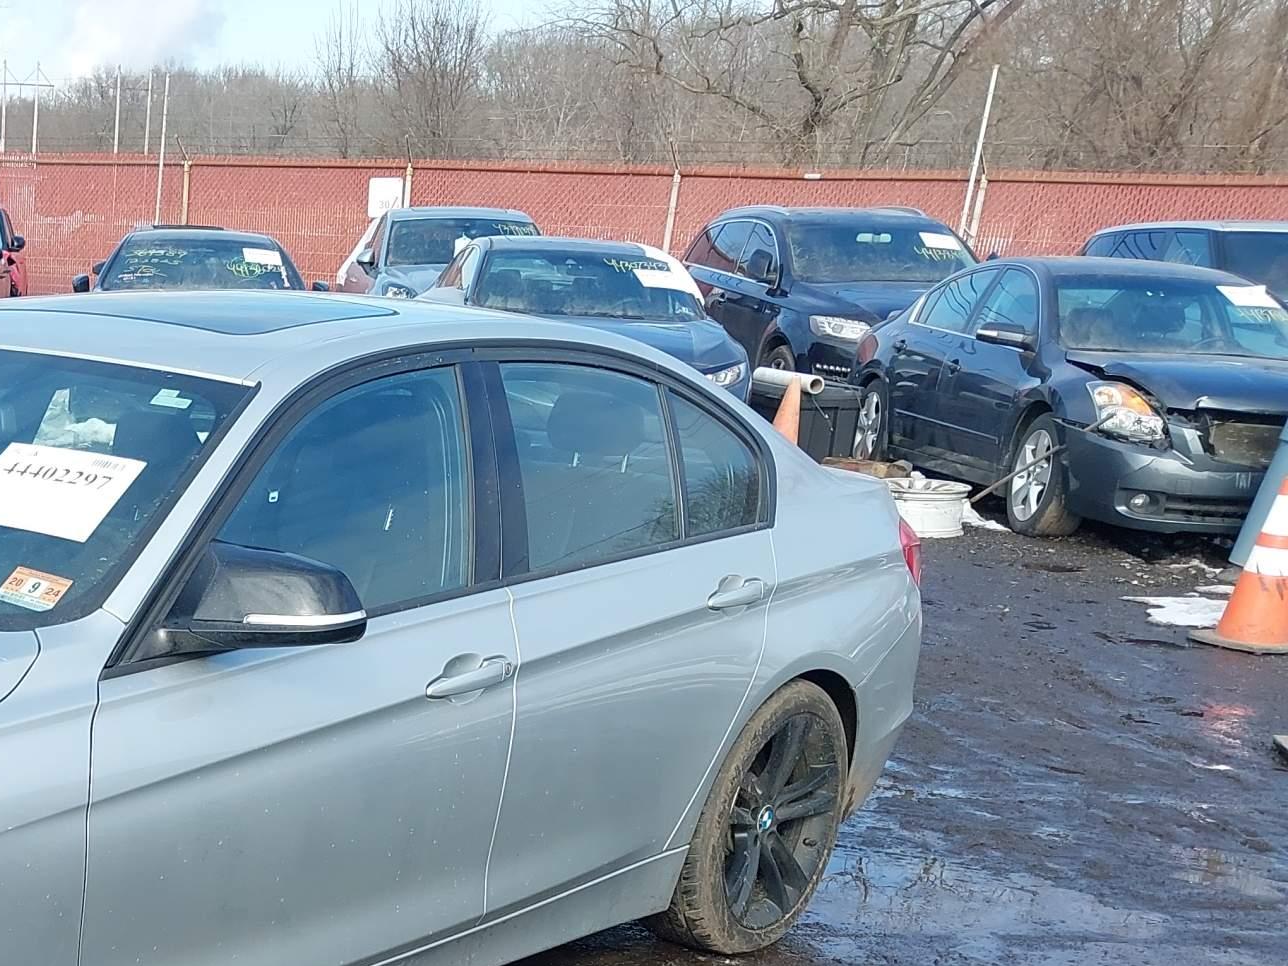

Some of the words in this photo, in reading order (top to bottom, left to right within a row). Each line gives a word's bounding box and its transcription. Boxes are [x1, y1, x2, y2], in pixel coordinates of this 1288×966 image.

[3, 462, 113, 490] 44402297
[8, 576, 24, 588] 20
[27, 581, 42, 594] 9
[43, 587, 62, 598] 24
